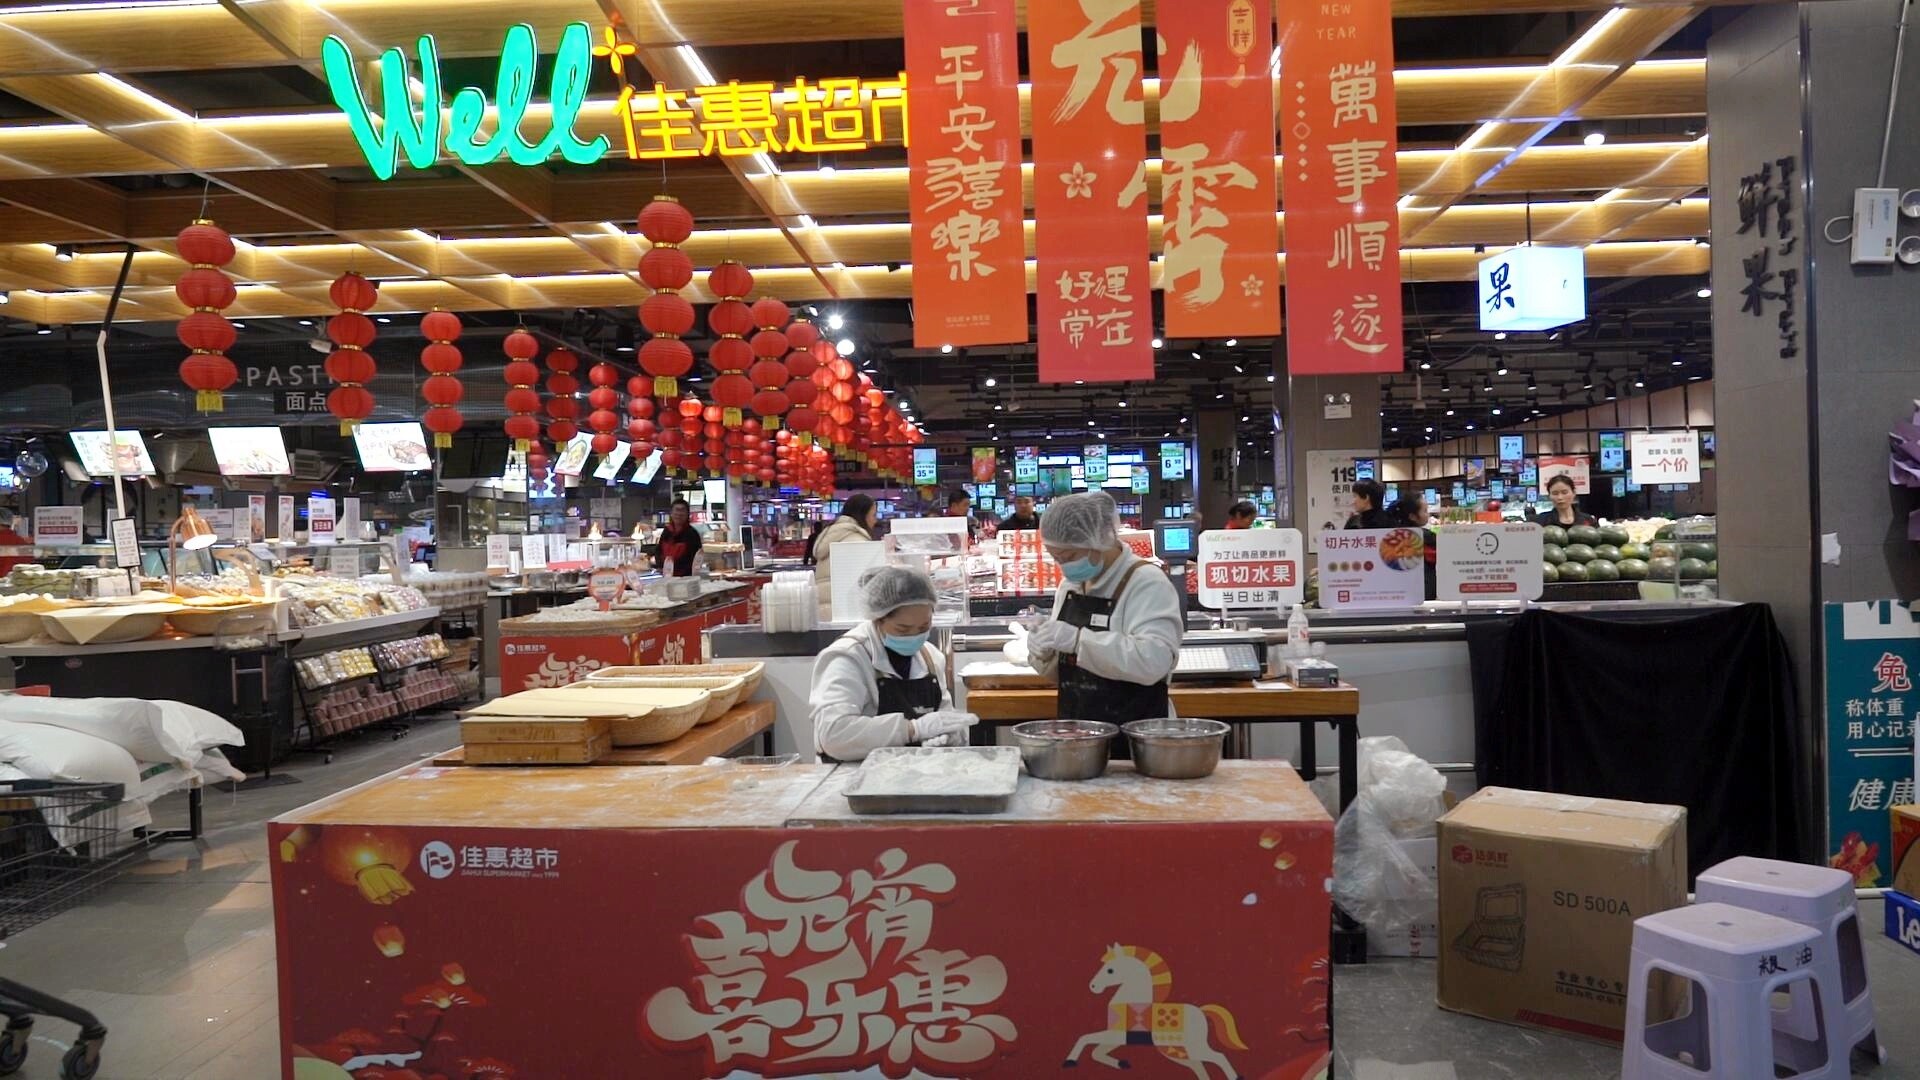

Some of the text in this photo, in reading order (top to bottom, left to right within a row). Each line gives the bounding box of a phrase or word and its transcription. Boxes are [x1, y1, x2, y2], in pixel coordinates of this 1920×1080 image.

[1321, 4, 1351, 16] NEW
[1231, 8, 1251, 49] 吉祥
[1317, 28, 1357, 41] YEAR
[321, 21, 611, 181] Well
[1326, 60, 1391, 354] 萬事順遂
[1486, 262, 1515, 313] 果
[1060, 308, 1134, 350] 常在
[247, 365, 333, 387] PAST
[285, 391, 328, 411] 面点
[1331, 467, 1356, 483] 119
[1641, 457, 1689, 473] 一个价
[1325, 535, 1377, 549] 切片水果
[1210, 564, 1290, 584] 现切水果
[1223, 590, 1279, 603] 当日出清
[1872, 652, 1912, 694] 免
[1845, 698, 1905, 717] 称体重
[460, 845, 559, 870] 佳惠超市
[745, 839, 956, 968] 元宵
[1553, 890, 1631, 916] SD 500A
